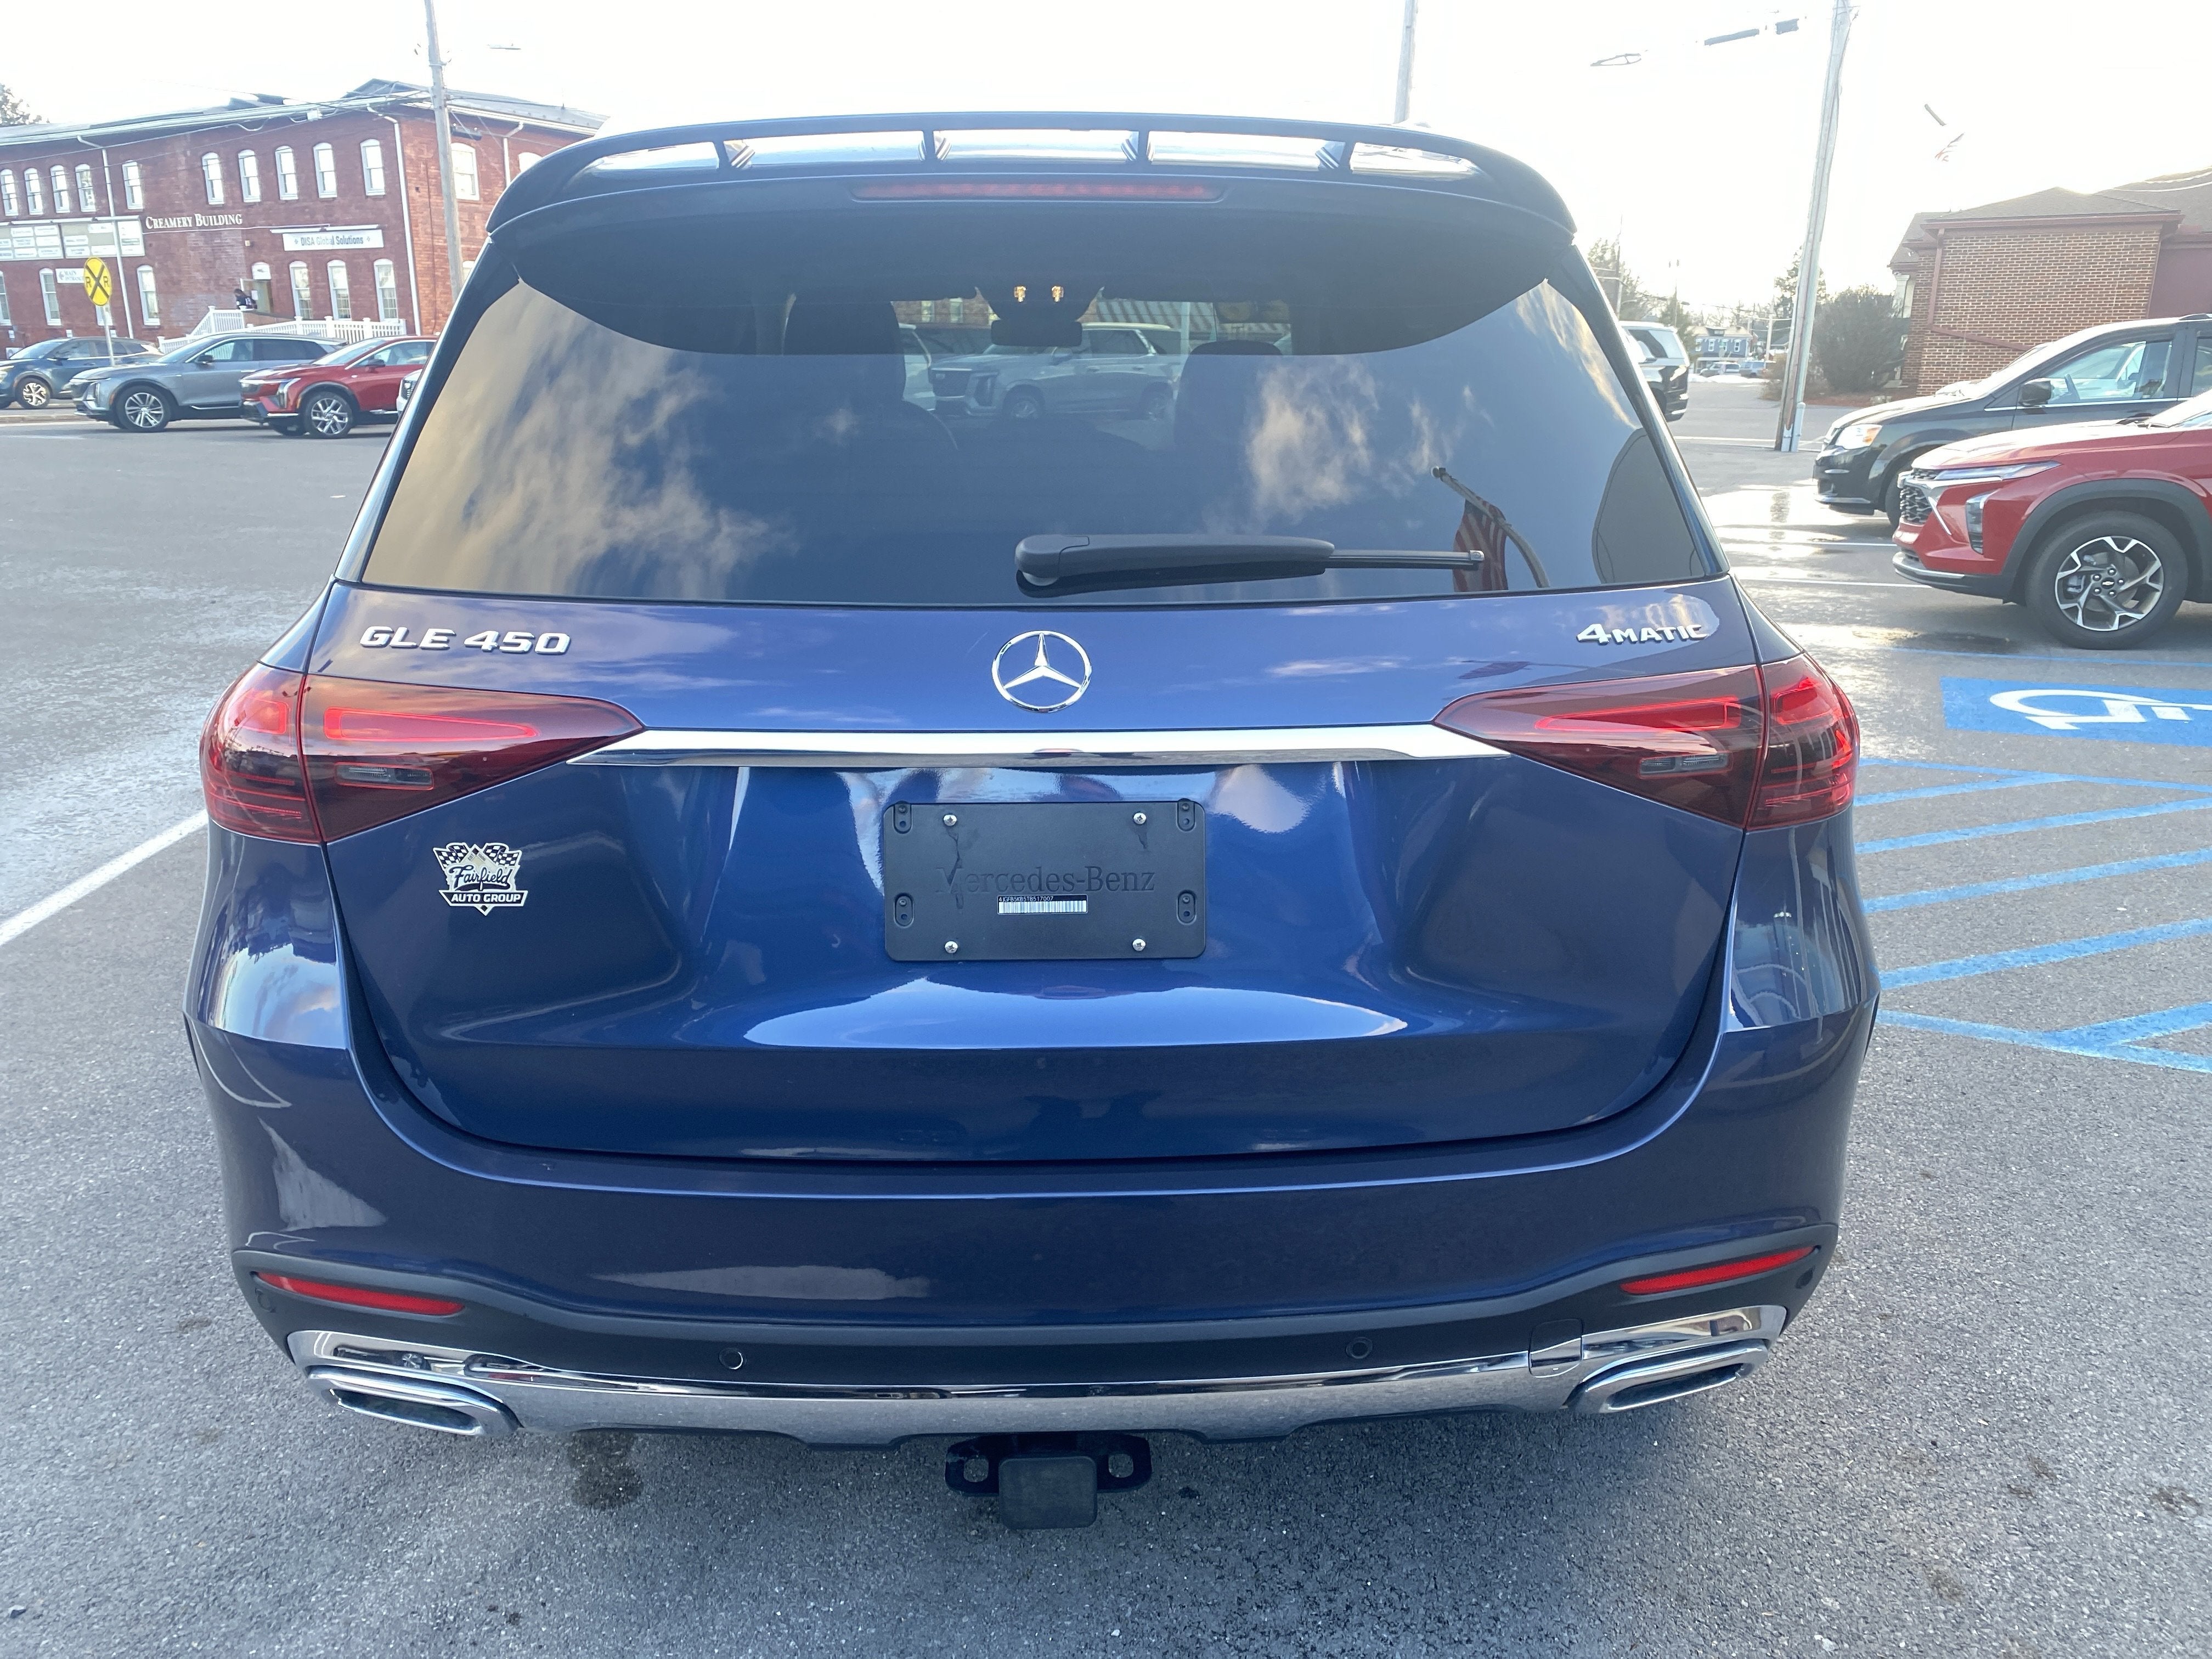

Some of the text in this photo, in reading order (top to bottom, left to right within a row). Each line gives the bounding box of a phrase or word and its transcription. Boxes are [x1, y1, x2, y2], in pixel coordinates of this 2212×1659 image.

[145, 213, 242, 229] CREAMERY BUILDING
[301, 235, 364, 246] DISA Global Solutions
[85, 276, 110, 287] R R
[360, 626, 572, 655] GLE 450
[1576, 623, 1707, 645] 4MATIC
[449, 865, 513, 889] Fairfield
[935, 866, 1155, 893] Mercedes-Benz
[451, 894, 521, 902] AUTO GROUP
